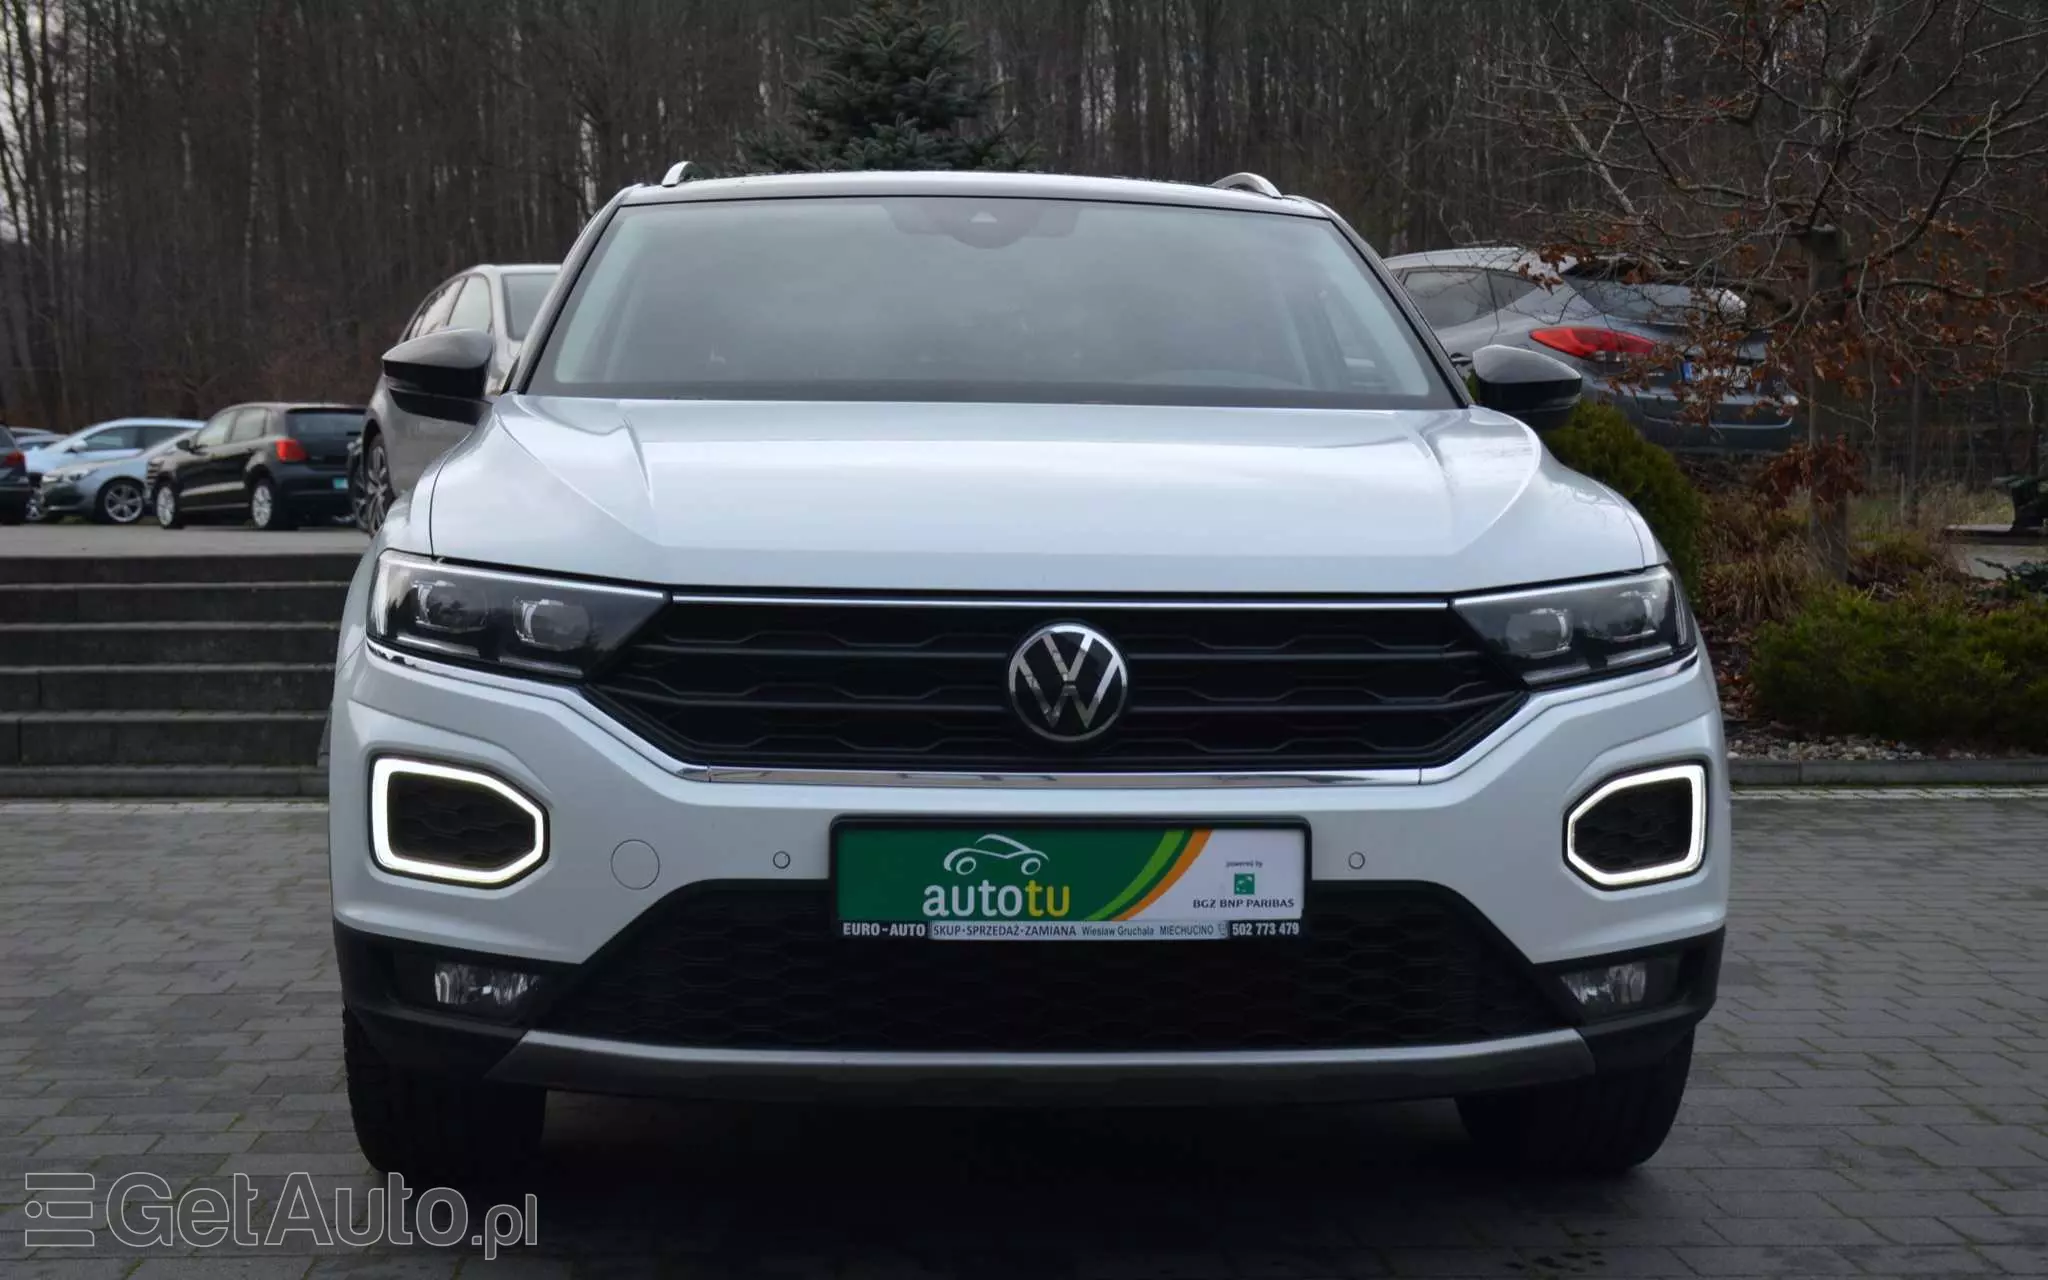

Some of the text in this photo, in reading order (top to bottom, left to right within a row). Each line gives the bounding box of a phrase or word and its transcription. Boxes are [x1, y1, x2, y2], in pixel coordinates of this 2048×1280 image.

[1013, 628, 1124, 732] VW
[922, 879, 1070, 917] autotu
[1220, 898, 1244, 909] BNP
[1246, 898, 1295, 909] PARIBAS
[1232, 922, 1300, 936] 502 773 479
